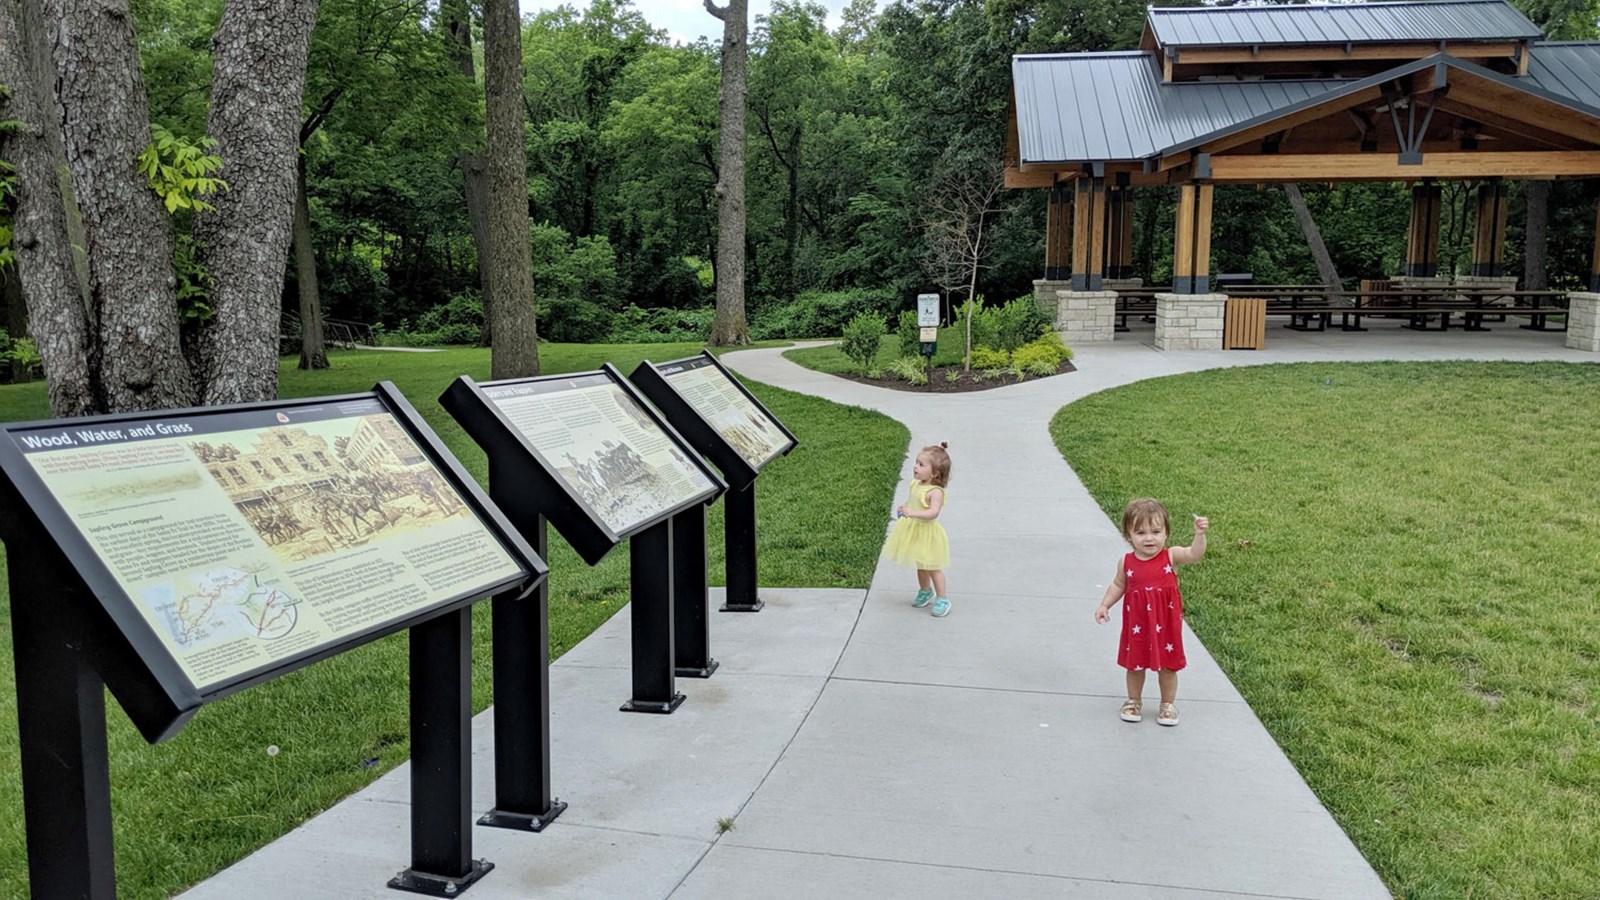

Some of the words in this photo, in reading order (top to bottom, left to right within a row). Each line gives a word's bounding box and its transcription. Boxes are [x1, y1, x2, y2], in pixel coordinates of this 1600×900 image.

[22, 429, 78, 450] Wood,
[77, 427, 128, 443] Water,
[128, 424, 155, 439] and
[156, 422, 193, 436] Grass
